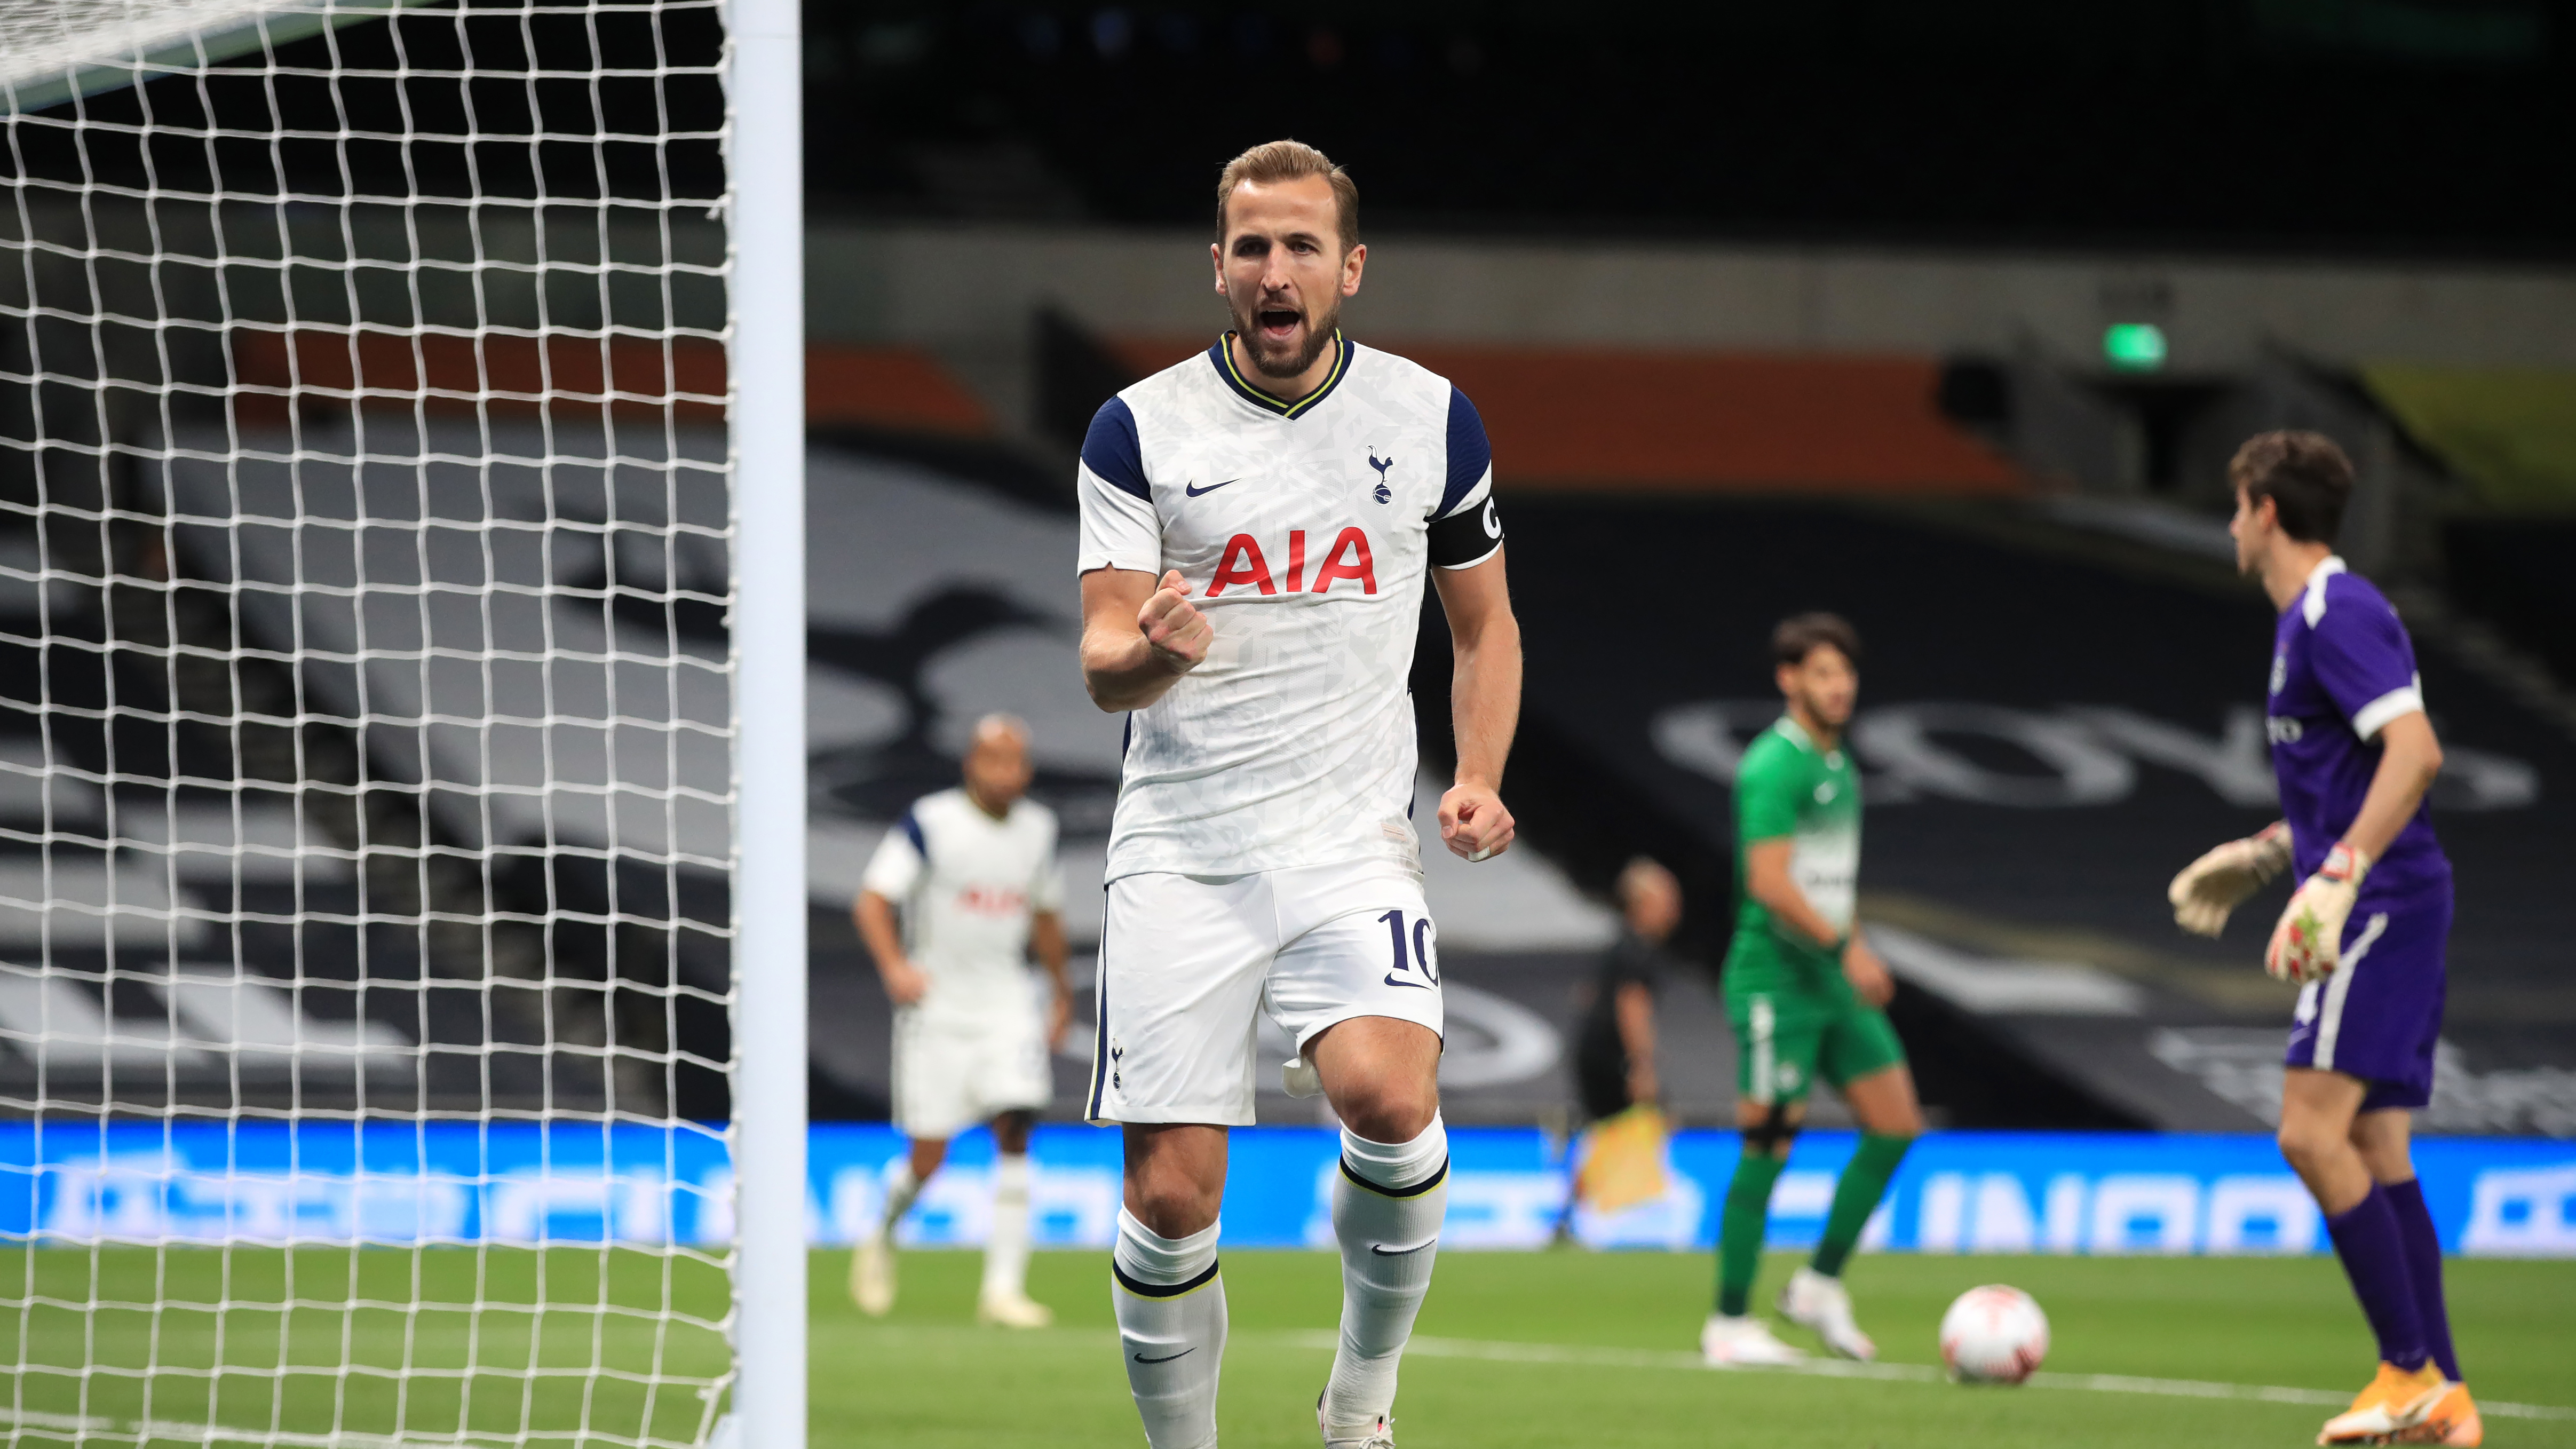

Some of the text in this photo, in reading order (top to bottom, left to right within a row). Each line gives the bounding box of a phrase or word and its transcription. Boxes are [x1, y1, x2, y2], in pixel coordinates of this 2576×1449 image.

[1483, 496, 1502, 539] C
[1204, 527, 1377, 597] AIA
[1377, 910, 1439, 987] 10
